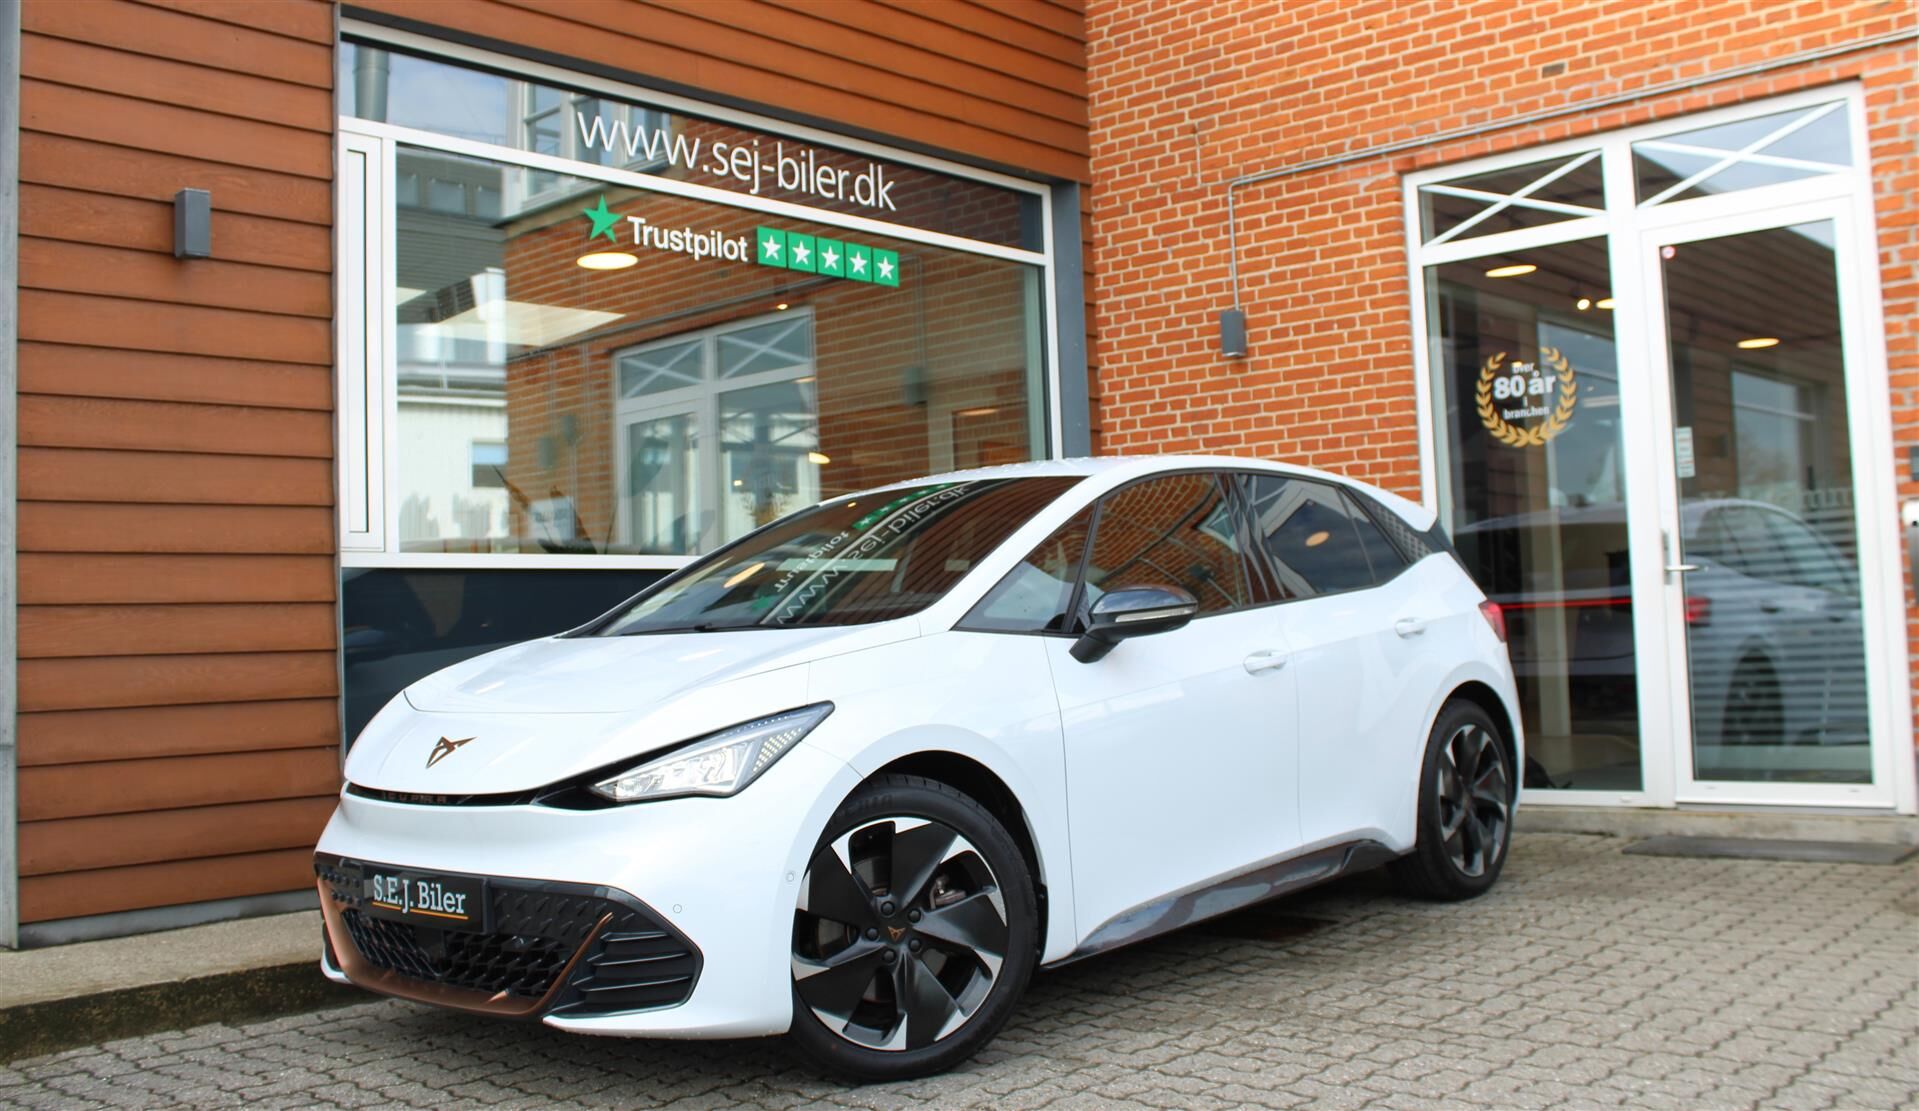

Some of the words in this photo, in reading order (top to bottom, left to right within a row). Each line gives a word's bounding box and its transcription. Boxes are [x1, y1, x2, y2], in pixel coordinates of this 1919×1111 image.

[577, 111, 897, 211] www.sej-biler.dk
[627, 216, 748, 262] Trustpilot
[1493, 375, 1526, 400] 80
[1528, 370, 1557, 396] år
[1503, 406, 1550, 420] branchen
[373, 874, 414, 914] S.E.J.
[417, 881, 467, 914] Biler
